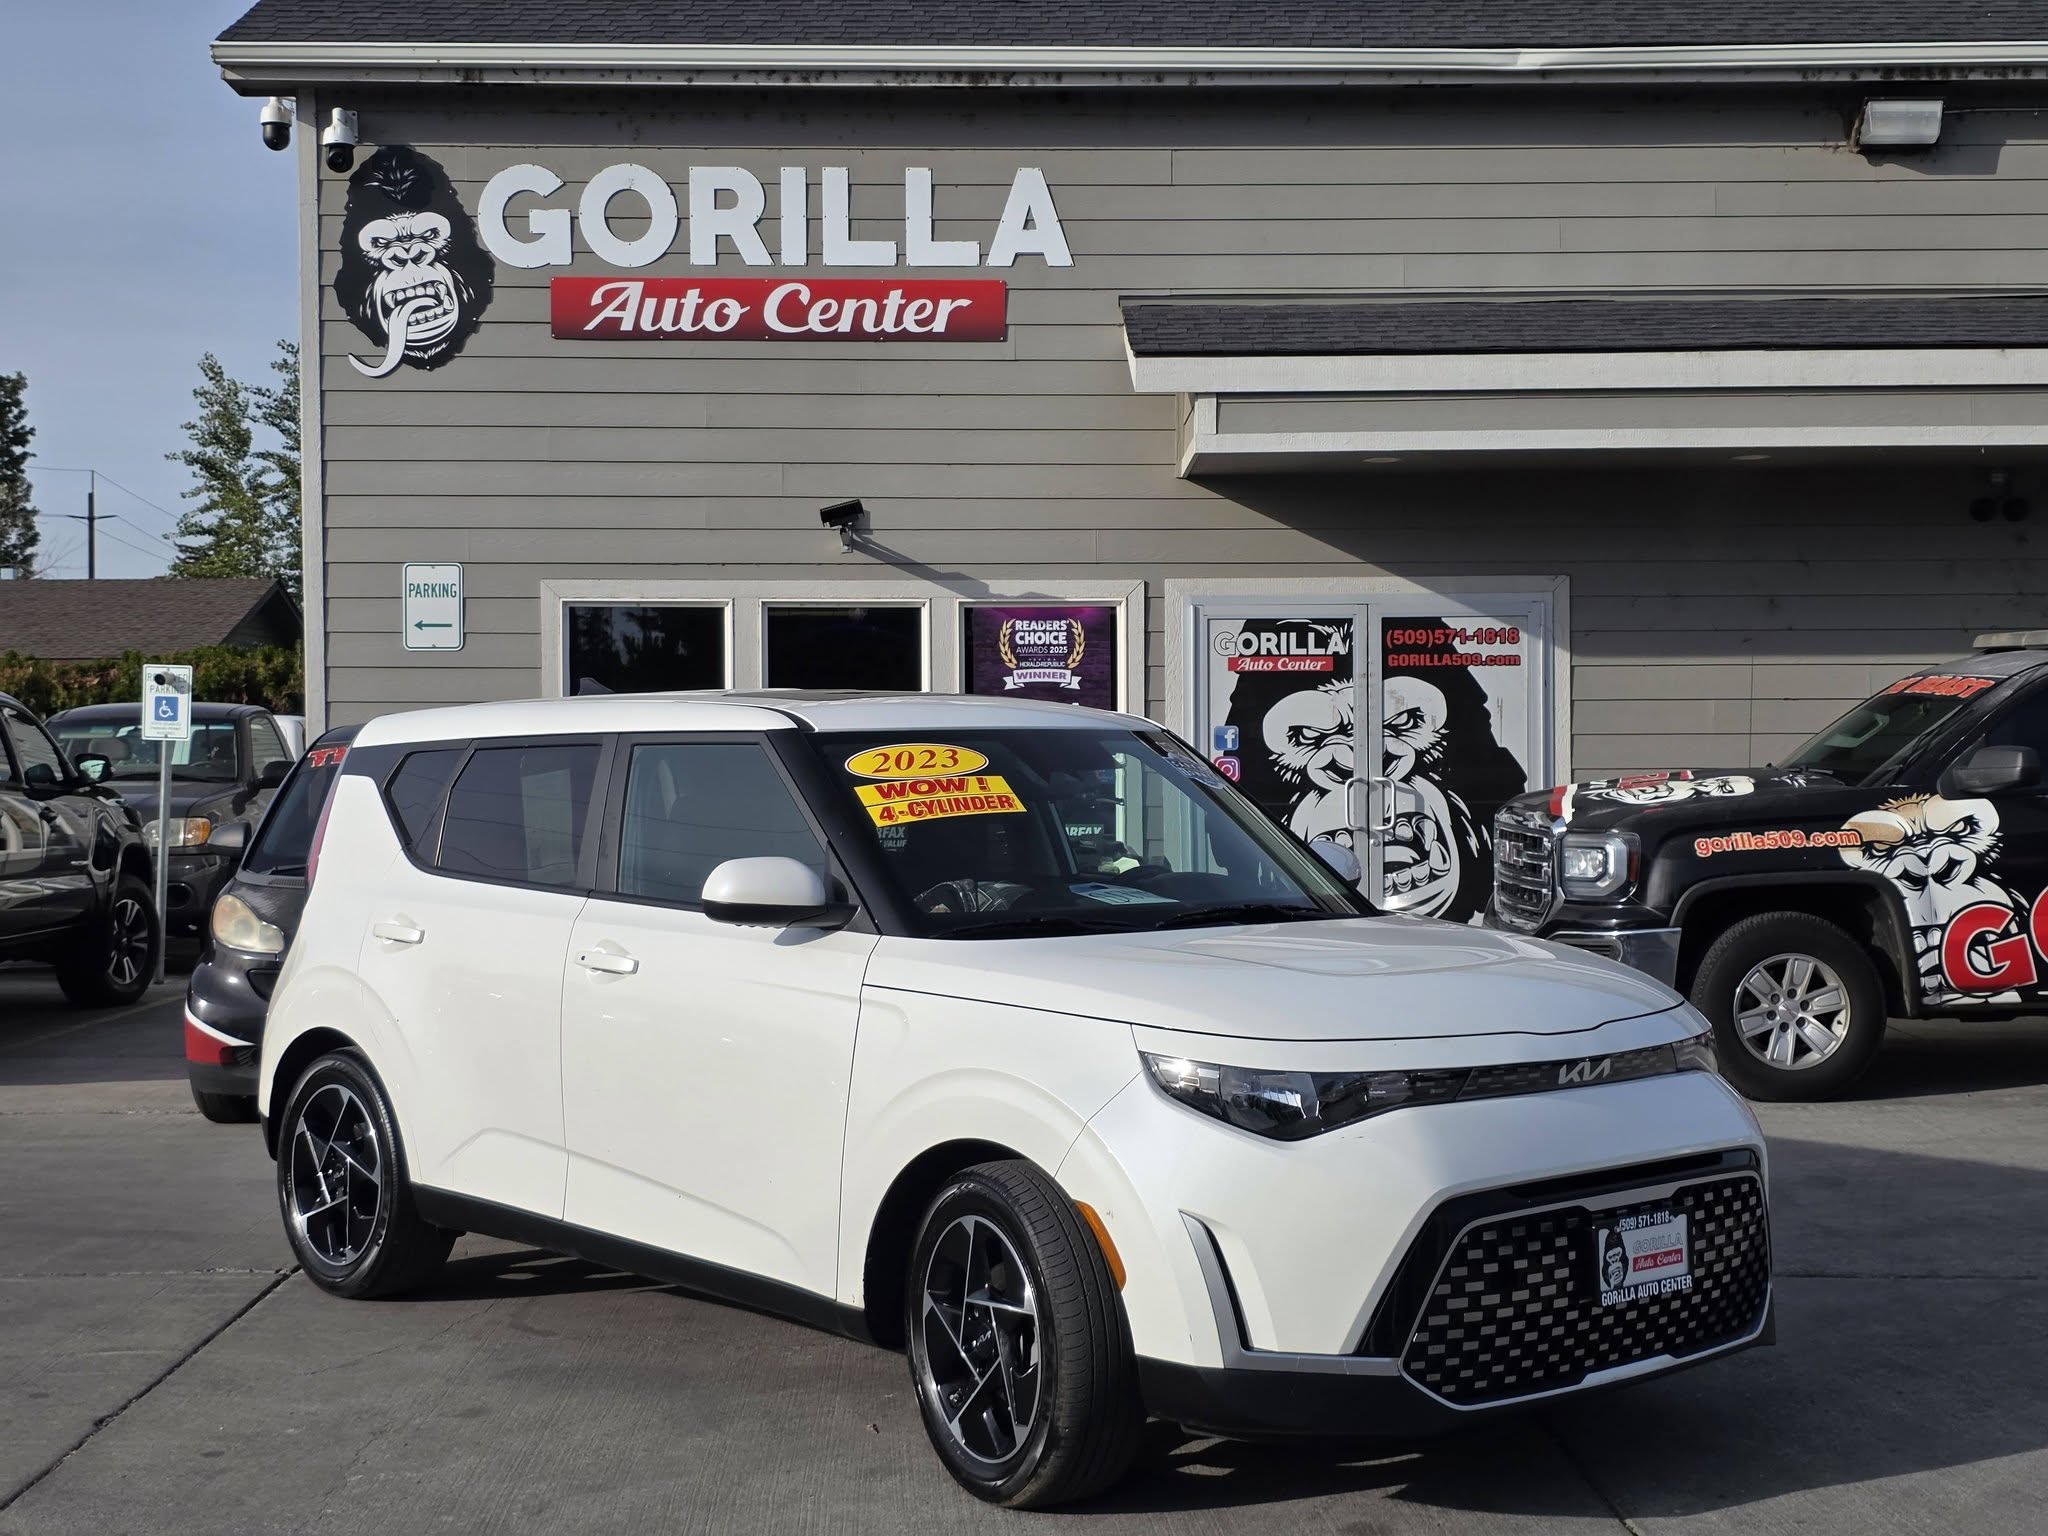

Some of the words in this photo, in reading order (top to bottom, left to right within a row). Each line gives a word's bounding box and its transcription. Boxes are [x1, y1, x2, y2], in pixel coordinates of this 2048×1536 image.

[477, 163, 1075, 268] GORILLA
[583, 280, 749, 332] Auto
[763, 281, 972, 334] Center
[408, 582, 457, 598] PARKING
[1015, 620, 1070, 631] READERS'
[1015, 631, 1068, 645] CHOICE
[1214, 631, 1347, 656] GORILLA
[1386, 627, 1520, 648] (509)571-1818
[1049, 646, 1068, 654] 2025
[1237, 657, 1274, 671] Auto
[1277, 657, 1326, 671] Center
[1388, 653, 1521, 667] GORILLA509.com
[1015, 671, 1067, 680] WINNER
[872, 748, 960, 774] 2023
[879, 794, 1018, 823] 4-CYLINDER
[1694, 830, 1861, 857] gorilla509.com
[1638, 1210, 1670, 1228] 571-1818
[1632, 1232, 1683, 1255] GORILLA
[1635, 1257, 1654, 1270] Auto
[1656, 1252, 1682, 1266] Center
[1601, 1286, 1637, 1307] GORILLA
[1637, 1282, 1659, 1299] AUTO
[1660, 1274, 1693, 1294] CENTER
